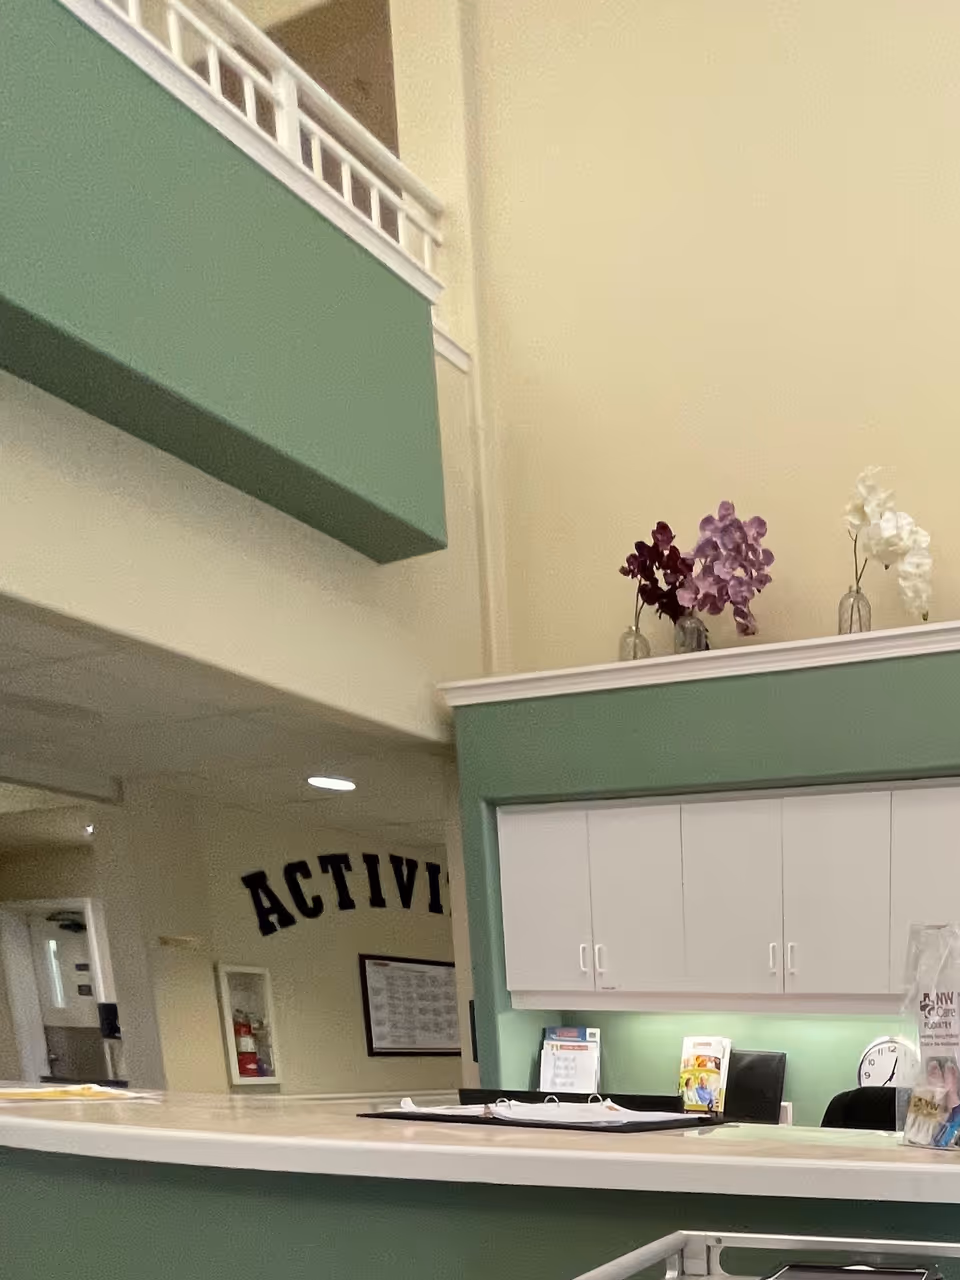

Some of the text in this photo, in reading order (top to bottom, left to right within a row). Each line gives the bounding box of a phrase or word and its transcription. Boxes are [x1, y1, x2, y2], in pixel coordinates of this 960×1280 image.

[241, 853, 451, 936] ACTIVI
[936, 991, 954, 1005] NW
[877, 1047, 884, 1056] 11
[888, 1045, 897, 1053] 12
[868, 1058, 876, 1067] 10
[864, 1071, 871, 1080] 9
